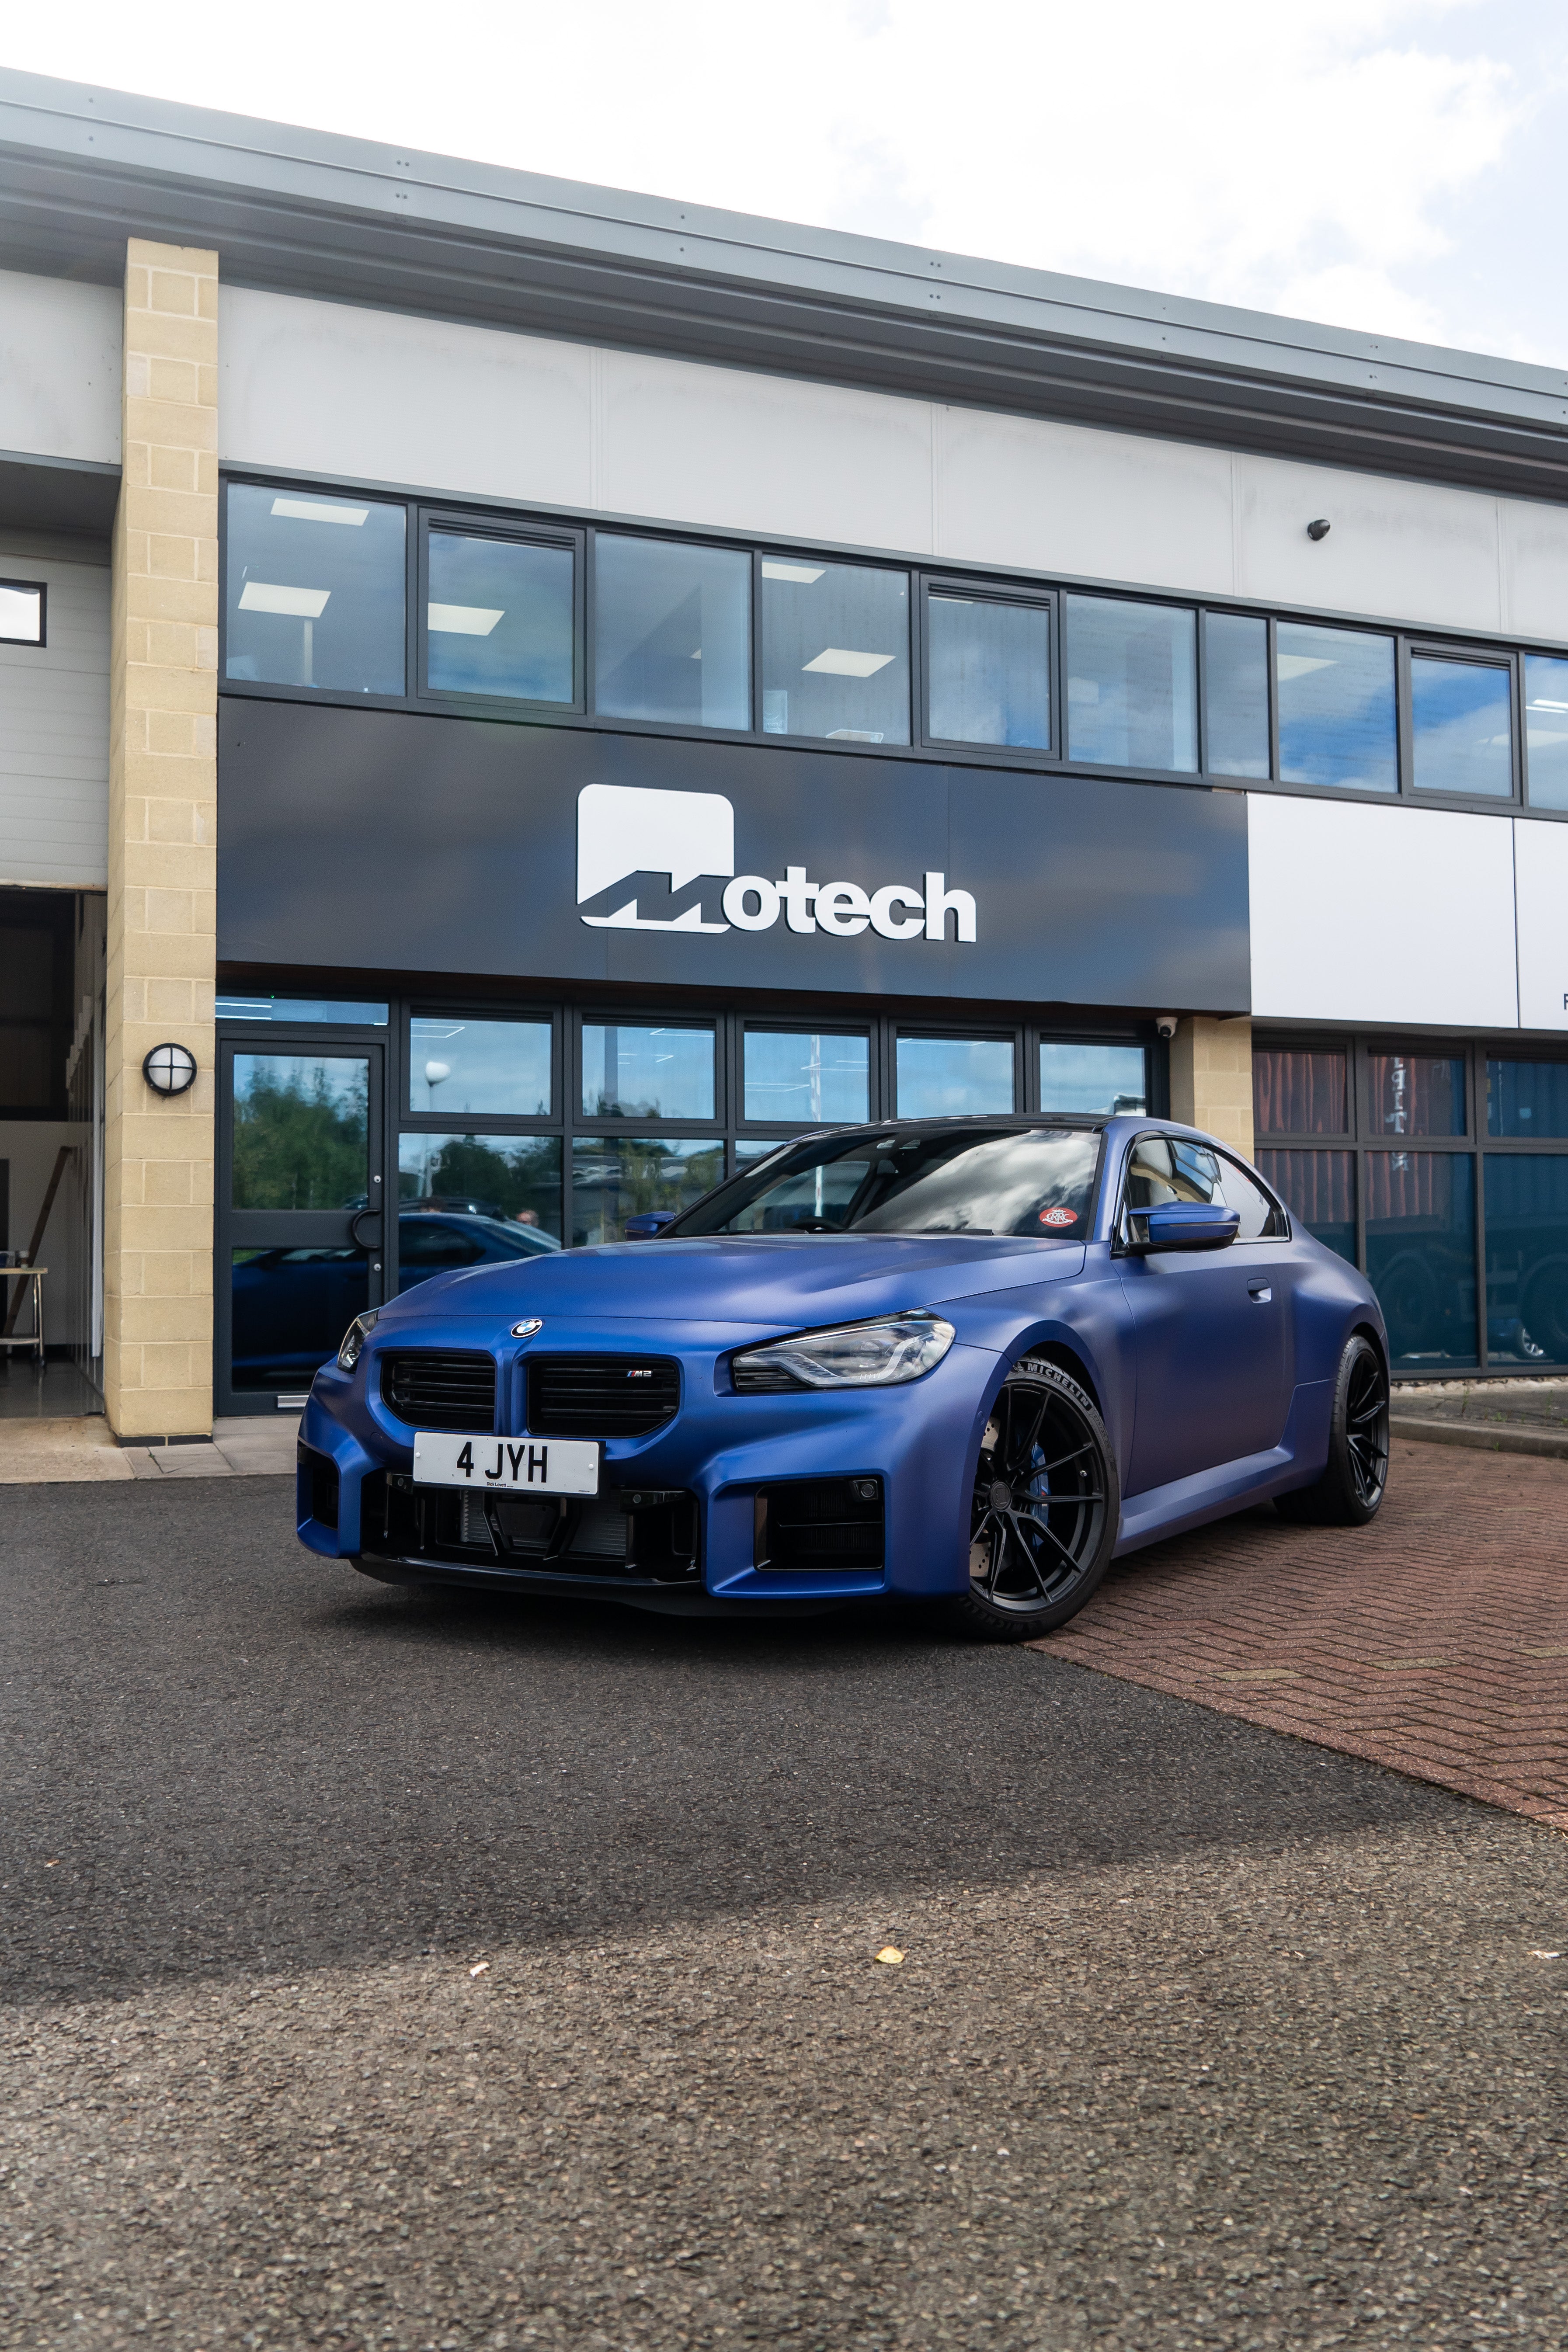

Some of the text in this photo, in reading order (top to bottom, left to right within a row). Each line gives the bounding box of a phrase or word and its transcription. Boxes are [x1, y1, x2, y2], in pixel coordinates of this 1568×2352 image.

[1046, 1212, 1070, 1223] GRRC
[1027, 1363, 1089, 1407] MICHELIN
[457, 1441, 548, 1483] 4 JYH
